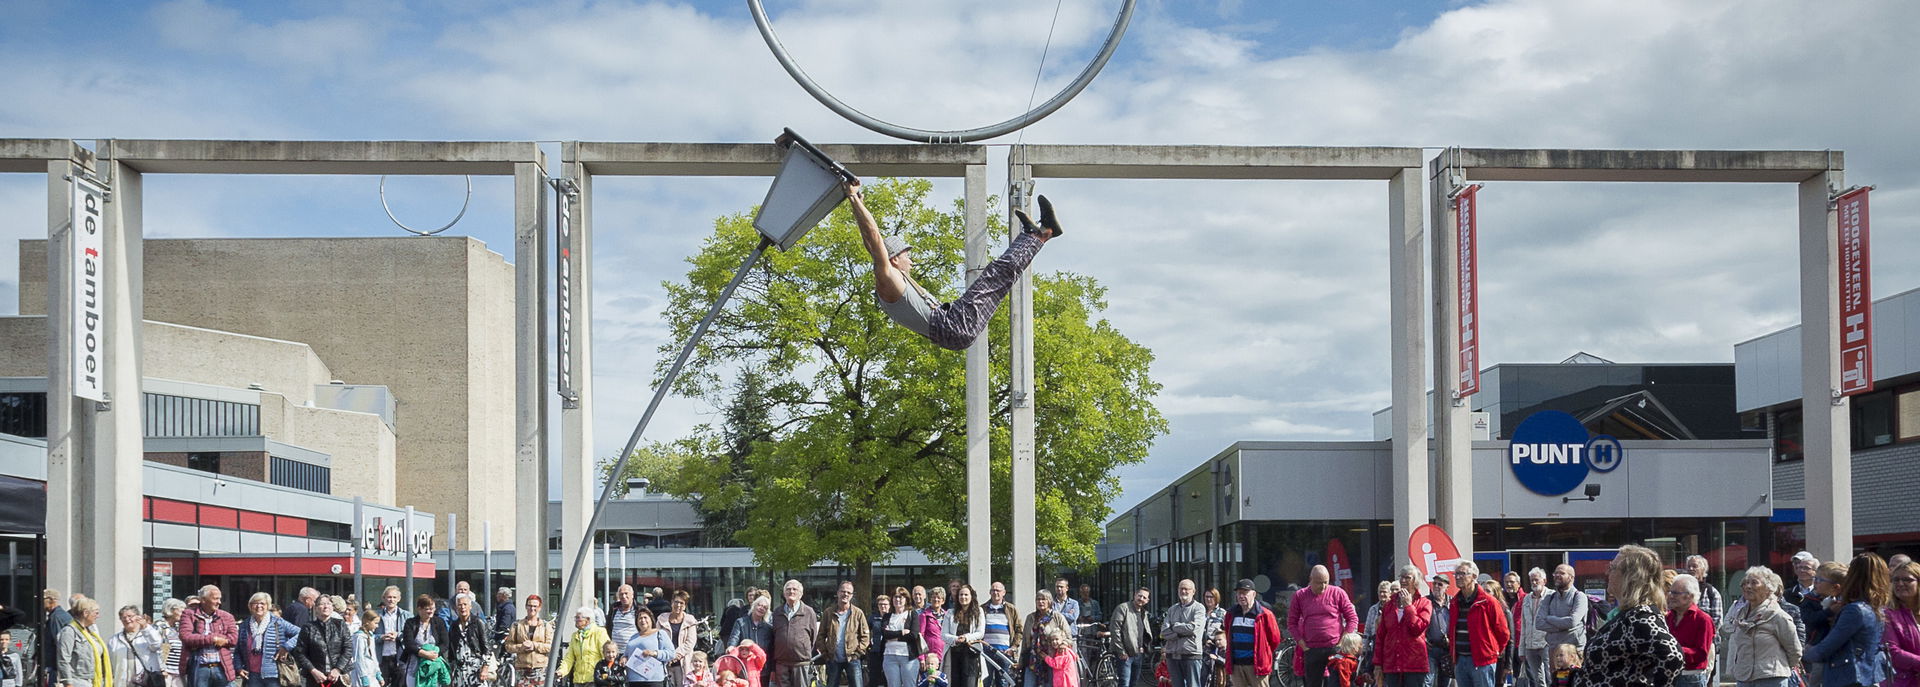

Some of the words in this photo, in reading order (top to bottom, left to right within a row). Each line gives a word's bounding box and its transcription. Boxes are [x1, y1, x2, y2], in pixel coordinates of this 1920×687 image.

[85, 193, 99, 235] de
[562, 194, 570, 237] de
[85, 247, 99, 390] tamboer
[562, 247, 571, 389] tamboer
[1846, 312, 1865, 344] H
[1512, 443, 1585, 465] PUNT
[1594, 444, 1613, 464] H
